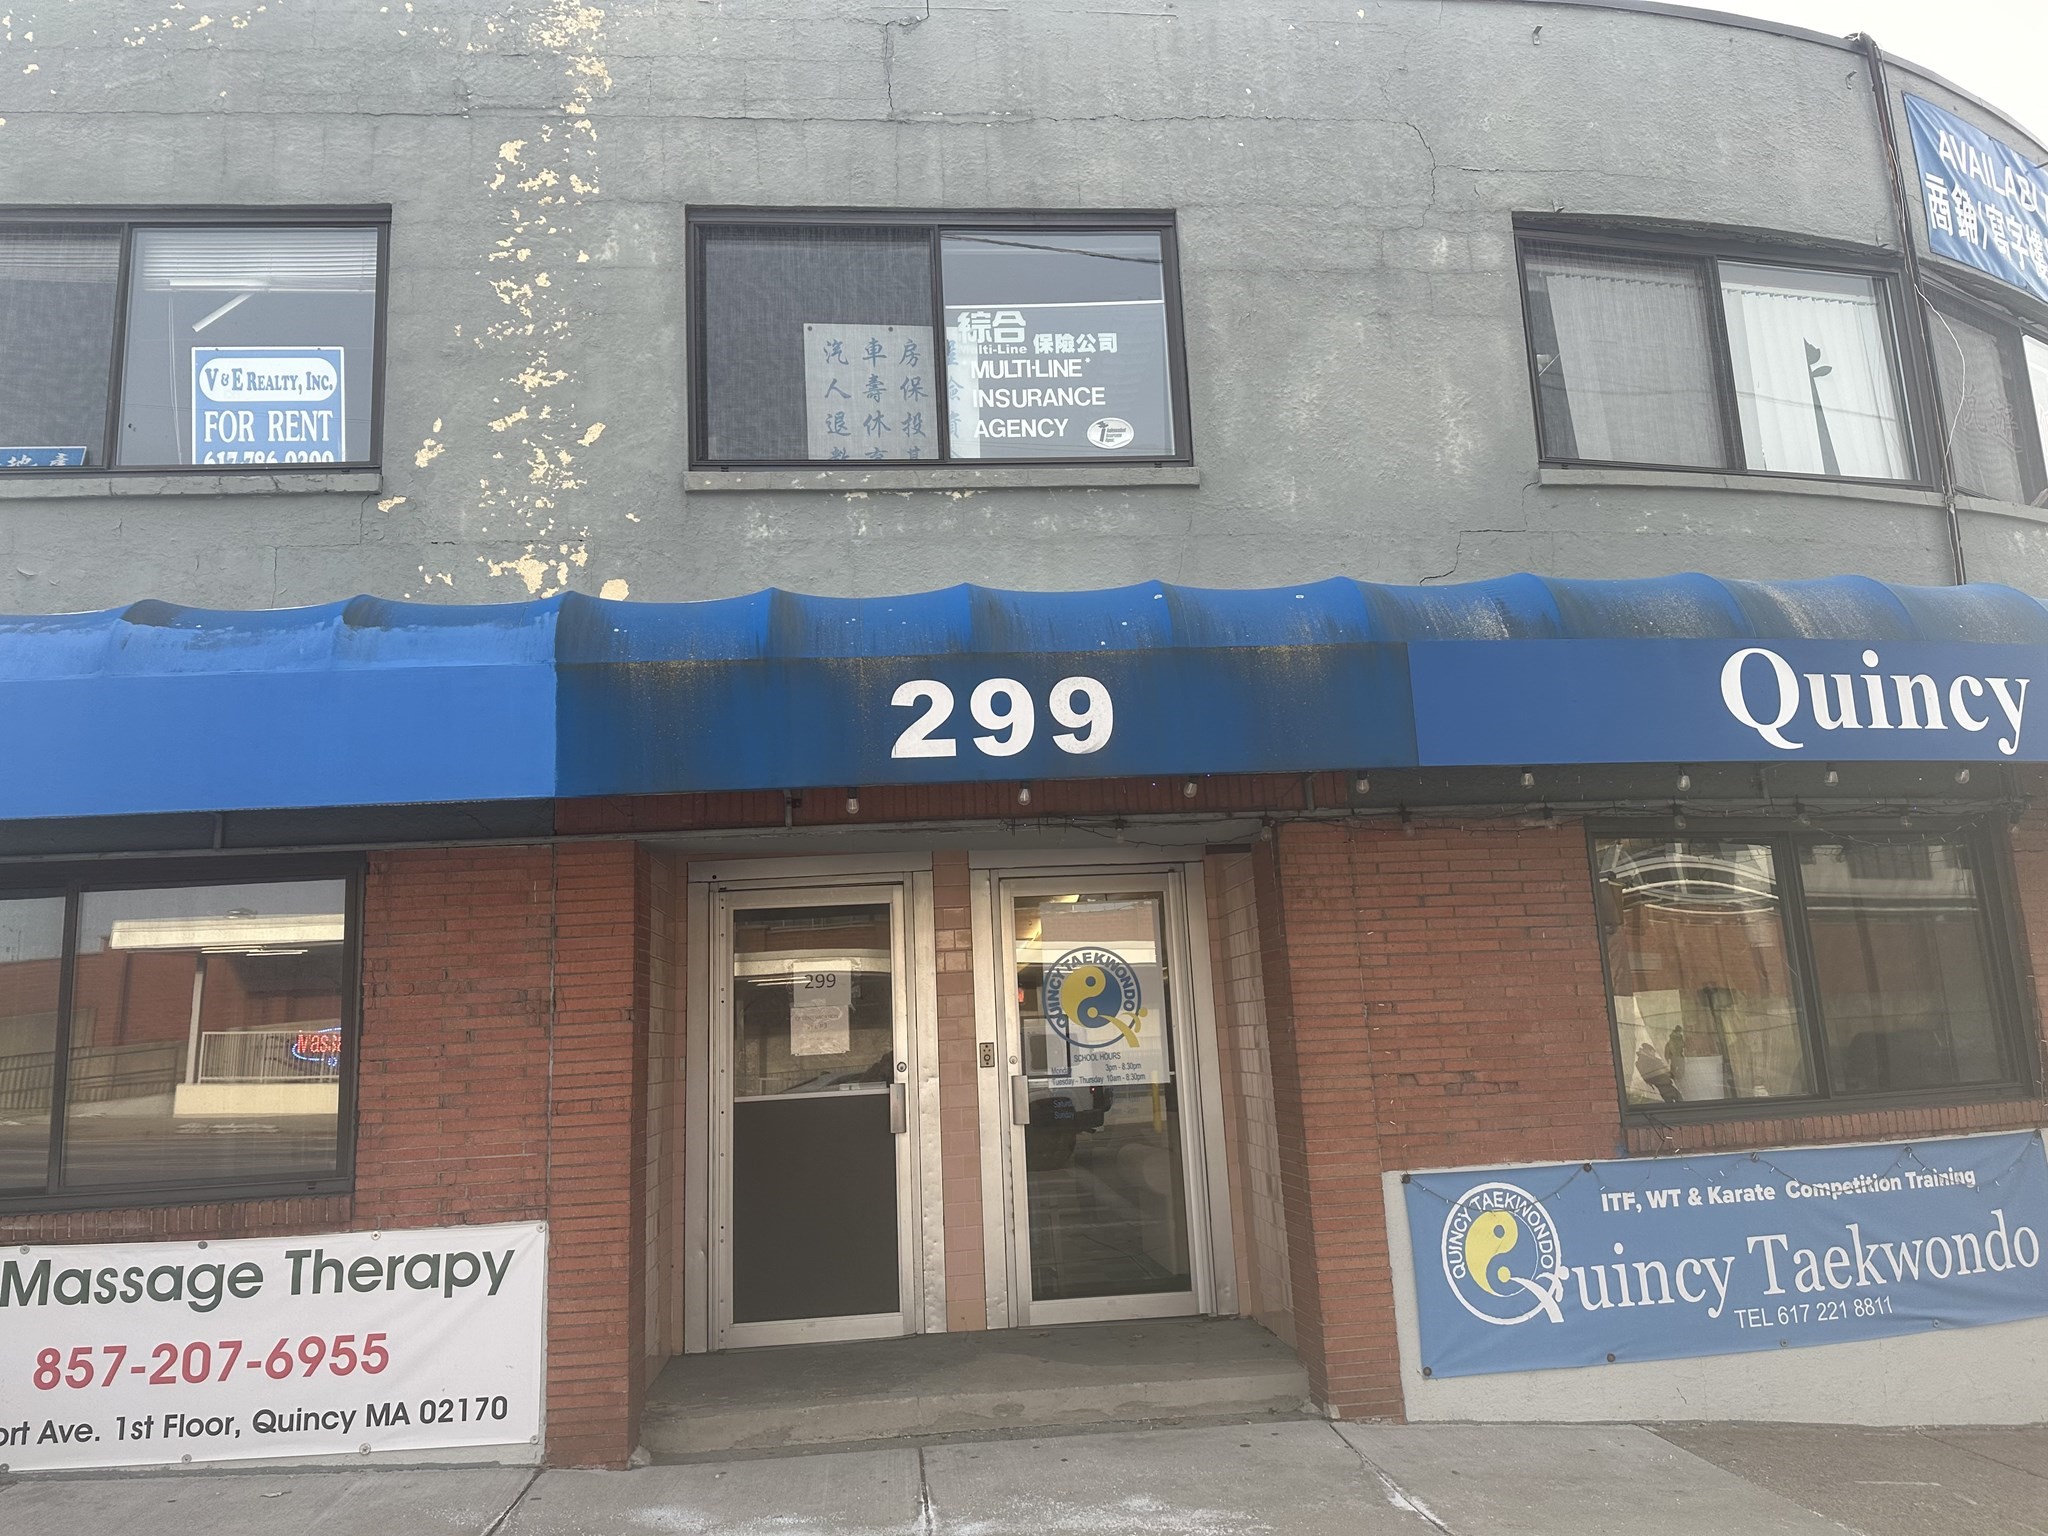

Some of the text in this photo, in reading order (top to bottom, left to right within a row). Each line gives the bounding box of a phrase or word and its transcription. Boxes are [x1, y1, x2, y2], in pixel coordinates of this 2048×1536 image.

[957, 310, 1117, 354] 綜合 保險公司
[973, 387, 1105, 408] INSURANCE
[204, 409, 333, 443] FOR RENT
[974, 418, 1068, 438] AGENCY
[891, 676, 1114, 759] 299
[1720, 646, 2031, 757] Quincy
[804, 973, 836, 989] 299
[1061, 952, 1136, 1011] TAEKWONDO
[1073, 1052, 1121, 1062] SCHOOL HOURS
[1601, 1169, 1975, 1213] ITF, WT & Karate Competition Training
[1449, 1191, 1554, 1279] QUINCY TAEKWONDO
[1746, 1209, 2039, 1296] Taekwondo
[0, 1247, 515, 1312] Massage Therapy
[1734, 1296, 1893, 1329] TEL 617 221 8811
[33, 1333, 389, 1391] 857-207-6955
[37, 1419, 100, 1445] Ave.
[116, 1415, 154, 1441] 1st
[163, 1413, 241, 1439] Floor,
[252, 1405, 356, 1434] Quincy
[366, 1401, 410, 1426] MA
[419, 1395, 509, 1424] 02170
